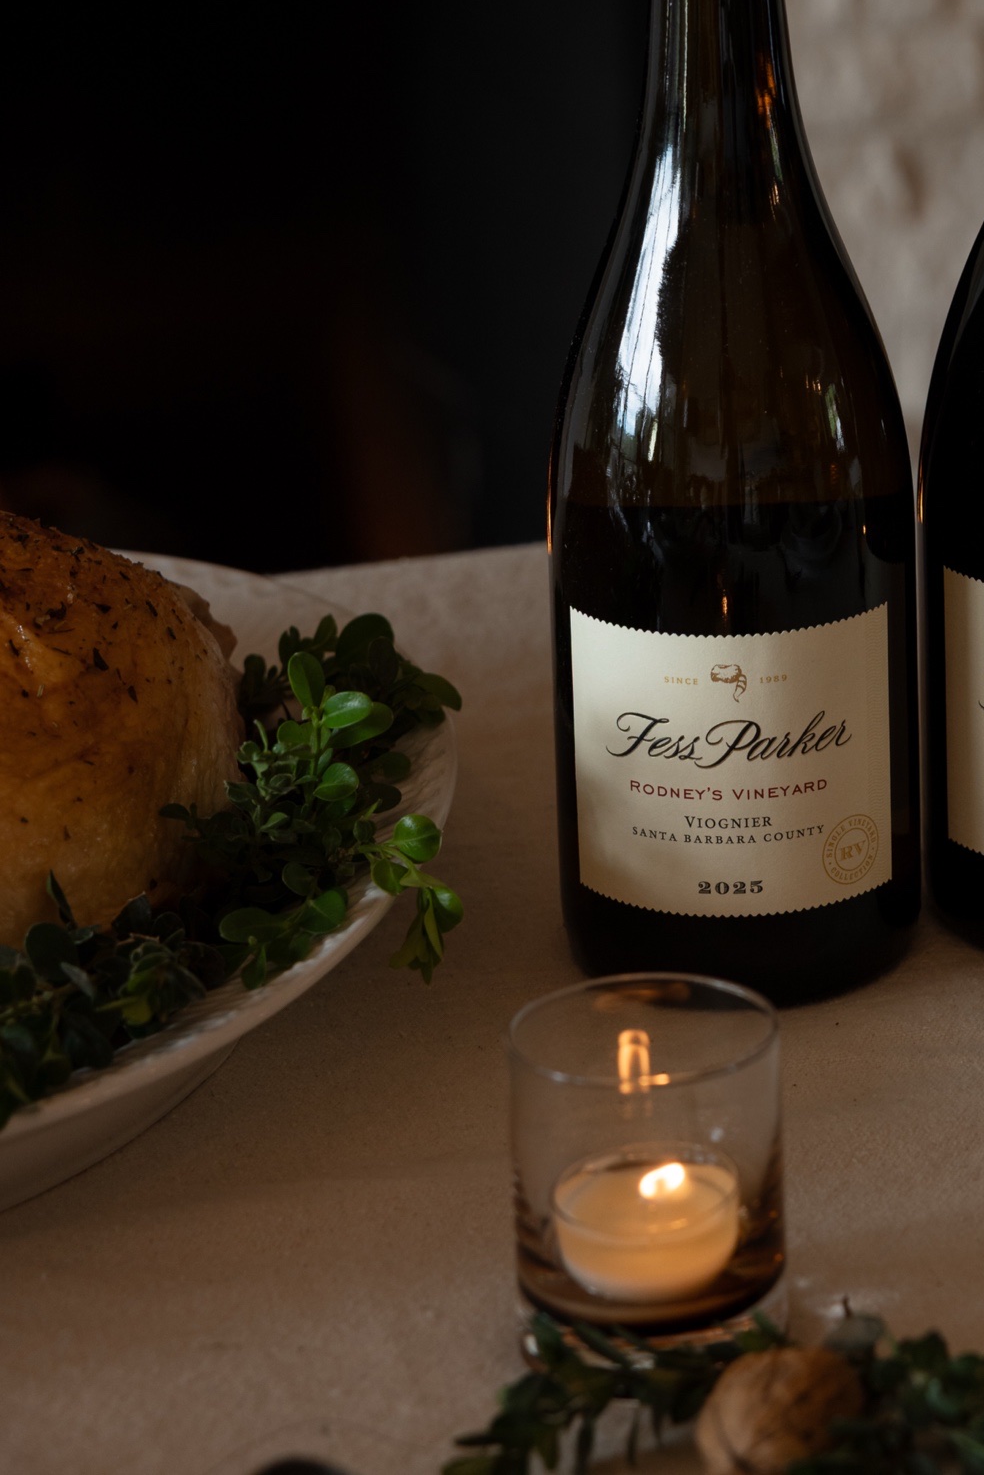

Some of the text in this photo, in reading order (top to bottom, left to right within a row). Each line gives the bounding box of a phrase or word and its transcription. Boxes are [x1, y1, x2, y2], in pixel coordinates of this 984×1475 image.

[664, 674, 788, 685] SINCE 1989
[606, 710, 852, 769] Fess Parker
[630, 779, 828, 801] RODNEY'S VINEYARD
[684, 815, 772, 830] VIOGNIER
[632, 825, 825, 845] SANTA BARBARA COUNTY
[839, 840, 866, 861] RV
[698, 880, 764, 895] 2025
